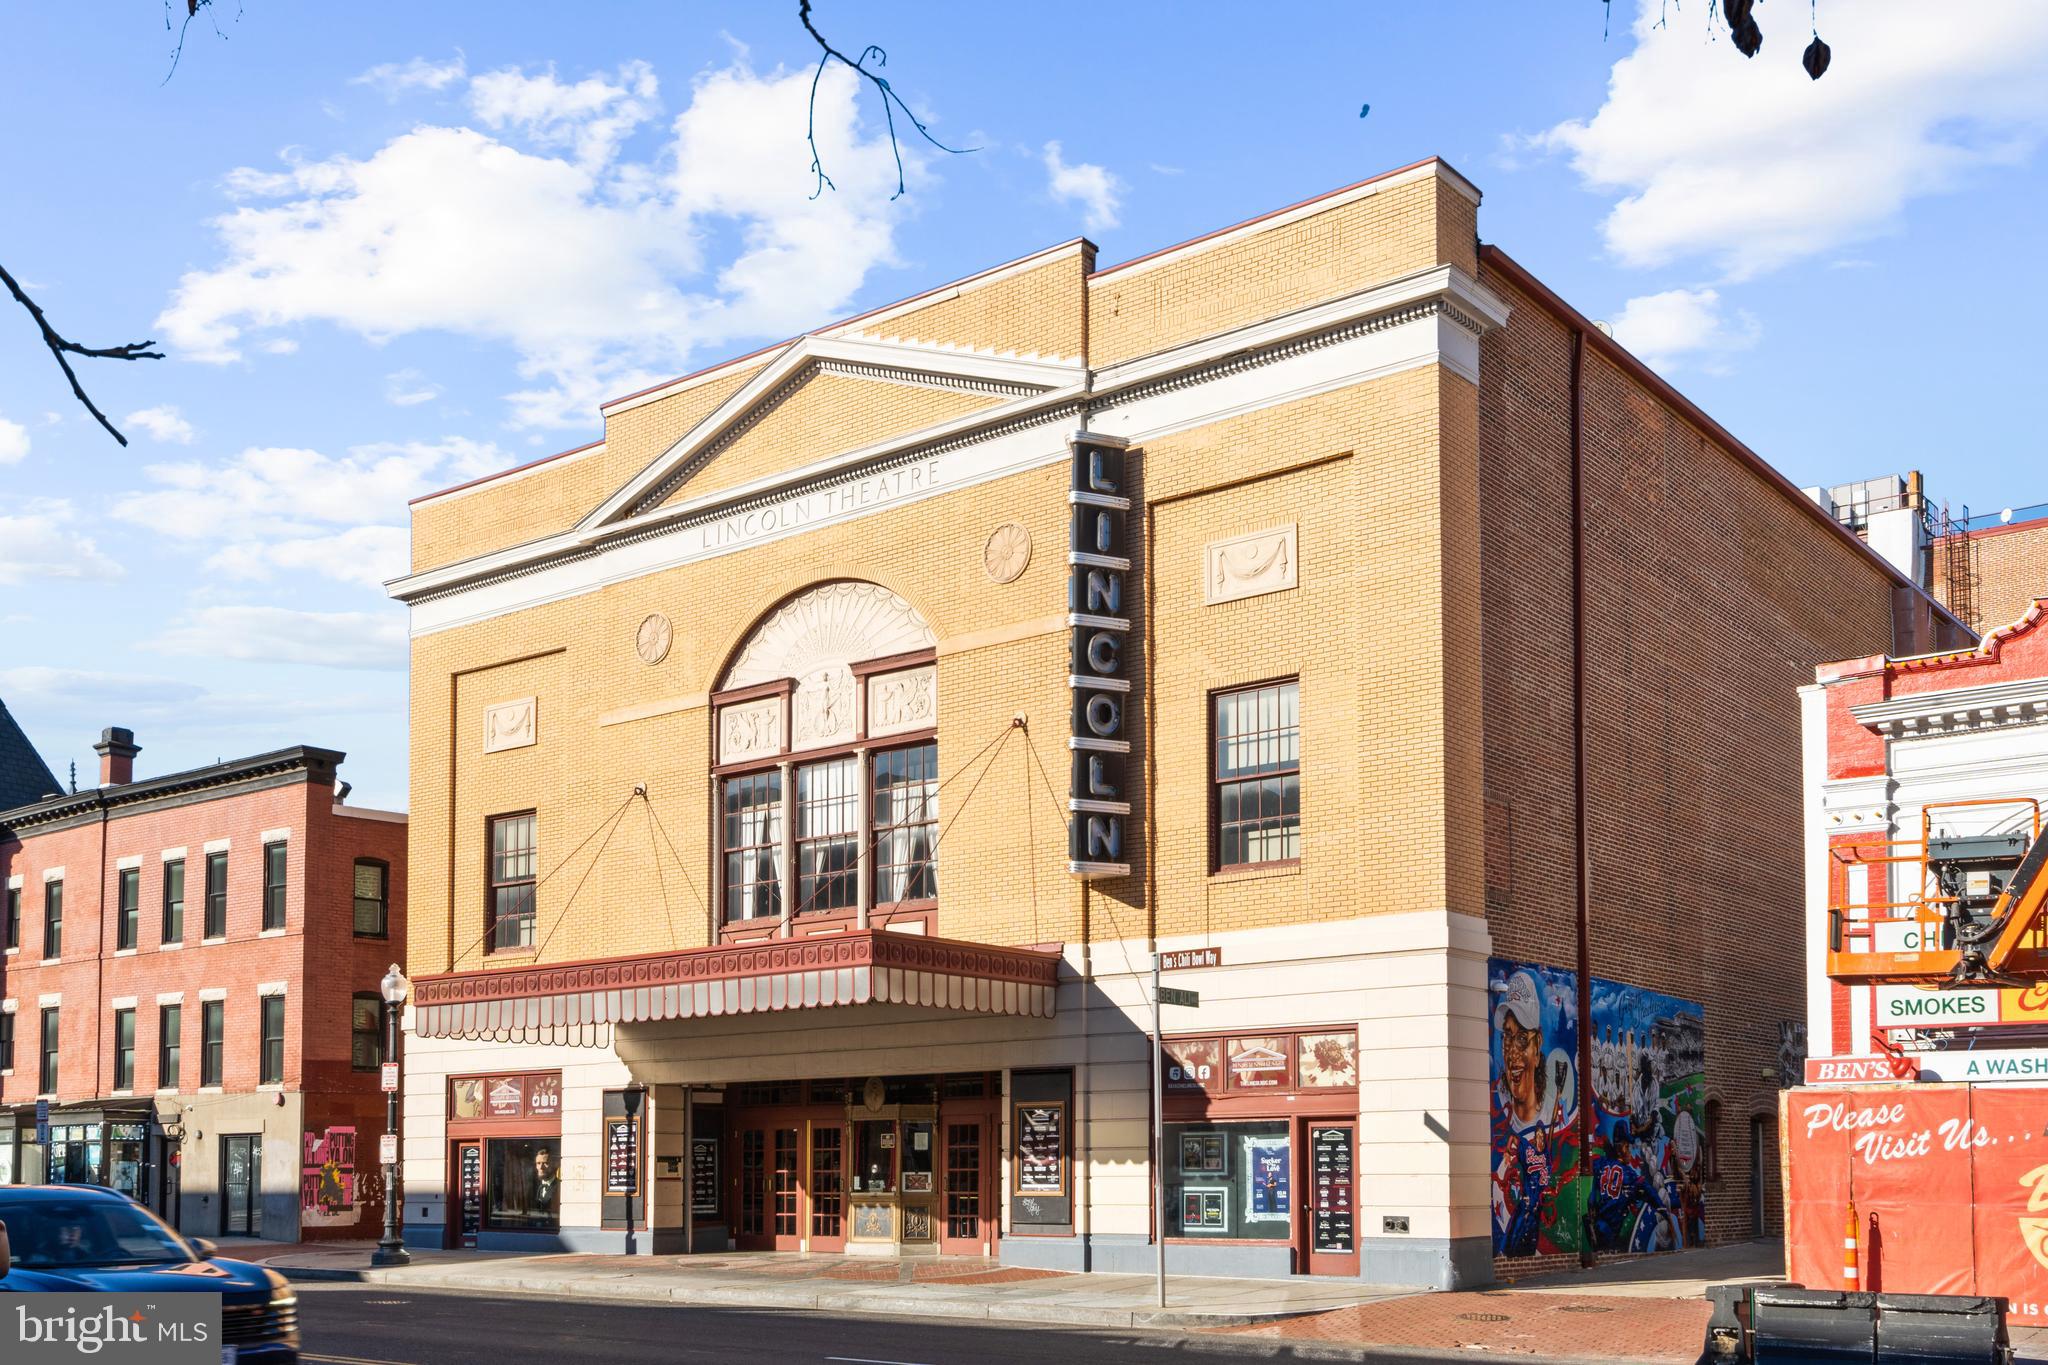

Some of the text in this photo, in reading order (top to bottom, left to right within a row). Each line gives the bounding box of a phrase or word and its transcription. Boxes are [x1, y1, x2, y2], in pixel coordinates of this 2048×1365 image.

[702, 460, 940, 549] LINCOLN THEATRE
[1087, 448, 1121, 859] LINCOLN
[1162, 949, 1217, 969] Ben's Chili Bowl Way
[1160, 988, 1176, 1003] BEN
[1890, 995, 1986, 1016] SMOKES
[1966, 1060, 1980, 1075] A
[1803, 1102, 1905, 1139] Please
[329, 1132, 354, 1148] PUTTING
[1855, 1130, 1931, 1165] Visit
[2023, 1302, 2039, 1316] IS
